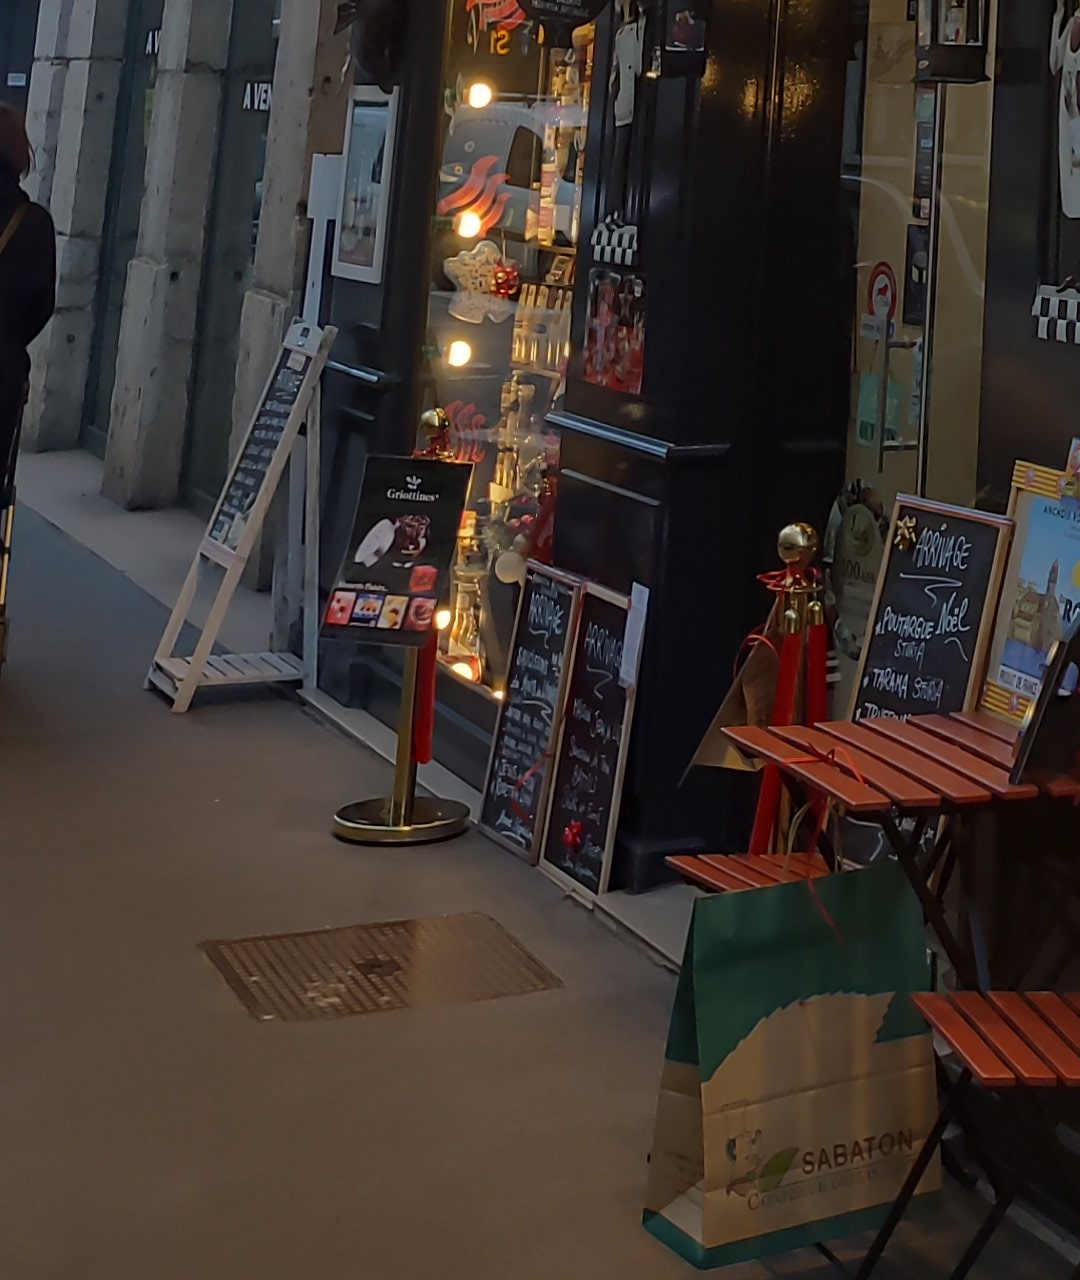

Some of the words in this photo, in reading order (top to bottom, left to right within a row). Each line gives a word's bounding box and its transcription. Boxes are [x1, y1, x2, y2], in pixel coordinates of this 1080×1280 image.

[243, 82, 251, 110] A
[386, 487, 436, 502] Griottines
[913, 523, 972, 572] ARRIVAGE
[936, 591, 970, 635] Noël
[801, 1127, 913, 1176] SABATON
